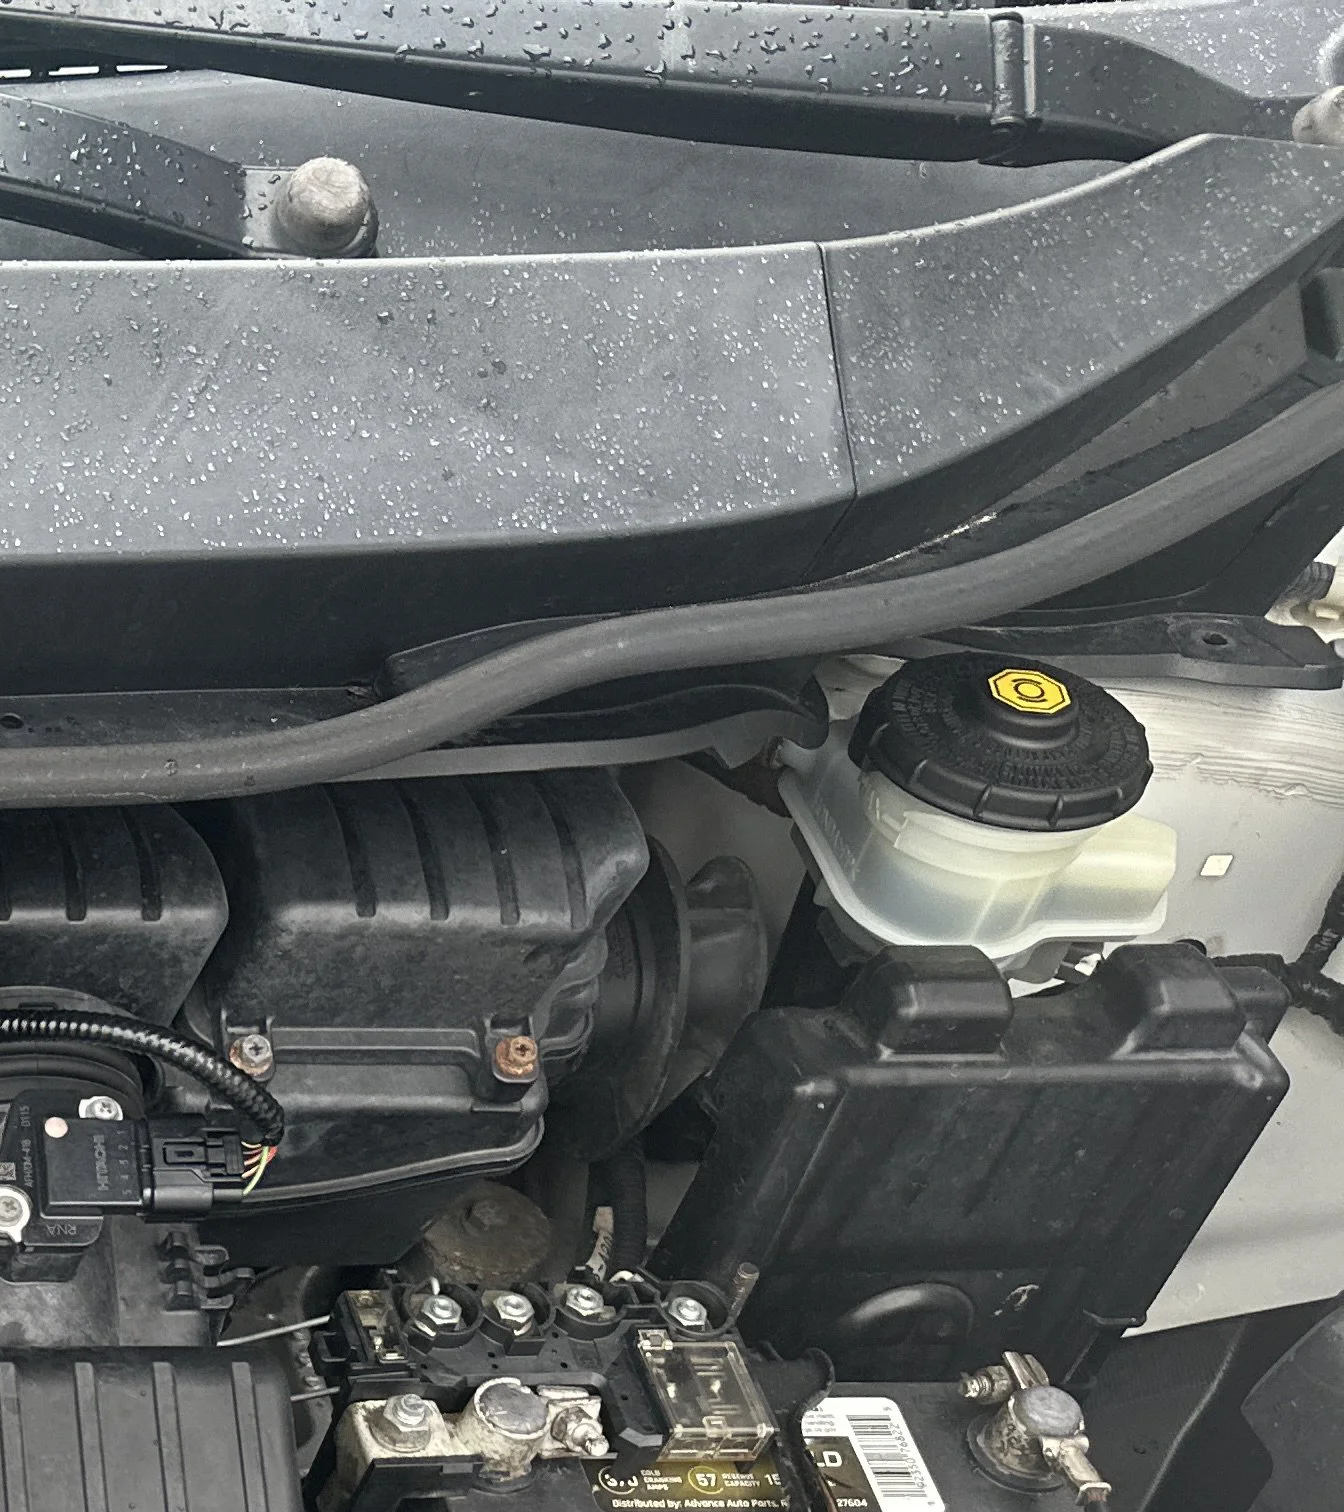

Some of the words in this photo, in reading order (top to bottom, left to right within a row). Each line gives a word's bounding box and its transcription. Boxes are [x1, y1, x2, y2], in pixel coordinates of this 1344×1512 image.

[92, 1133, 110, 1192] HITACHI
[45, 1223, 78, 1236] RNA
[695, 1472, 717, 1488] 57
[612, 1499, 666, 1509] Distributed
[684, 1499, 726, 1509] Advance
[727, 1499, 750, 1509] Auto
